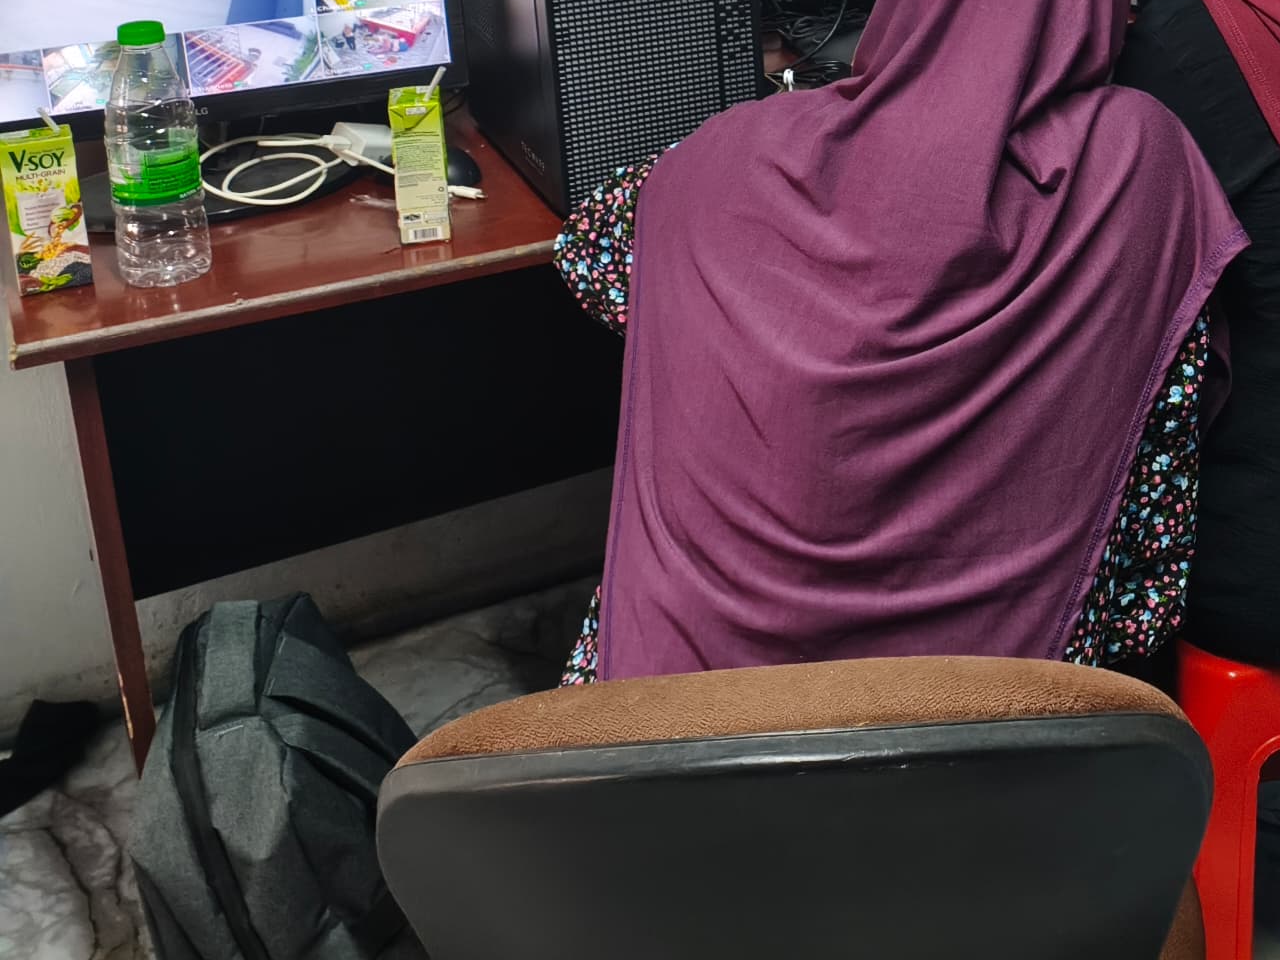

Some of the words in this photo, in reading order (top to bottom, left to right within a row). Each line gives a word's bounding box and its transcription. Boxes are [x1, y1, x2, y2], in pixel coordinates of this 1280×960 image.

[195, 106, 209, 116] LG
[8, 149, 65, 174] V-SOY
[15, 169, 67, 181] MULTI-GRAIN
